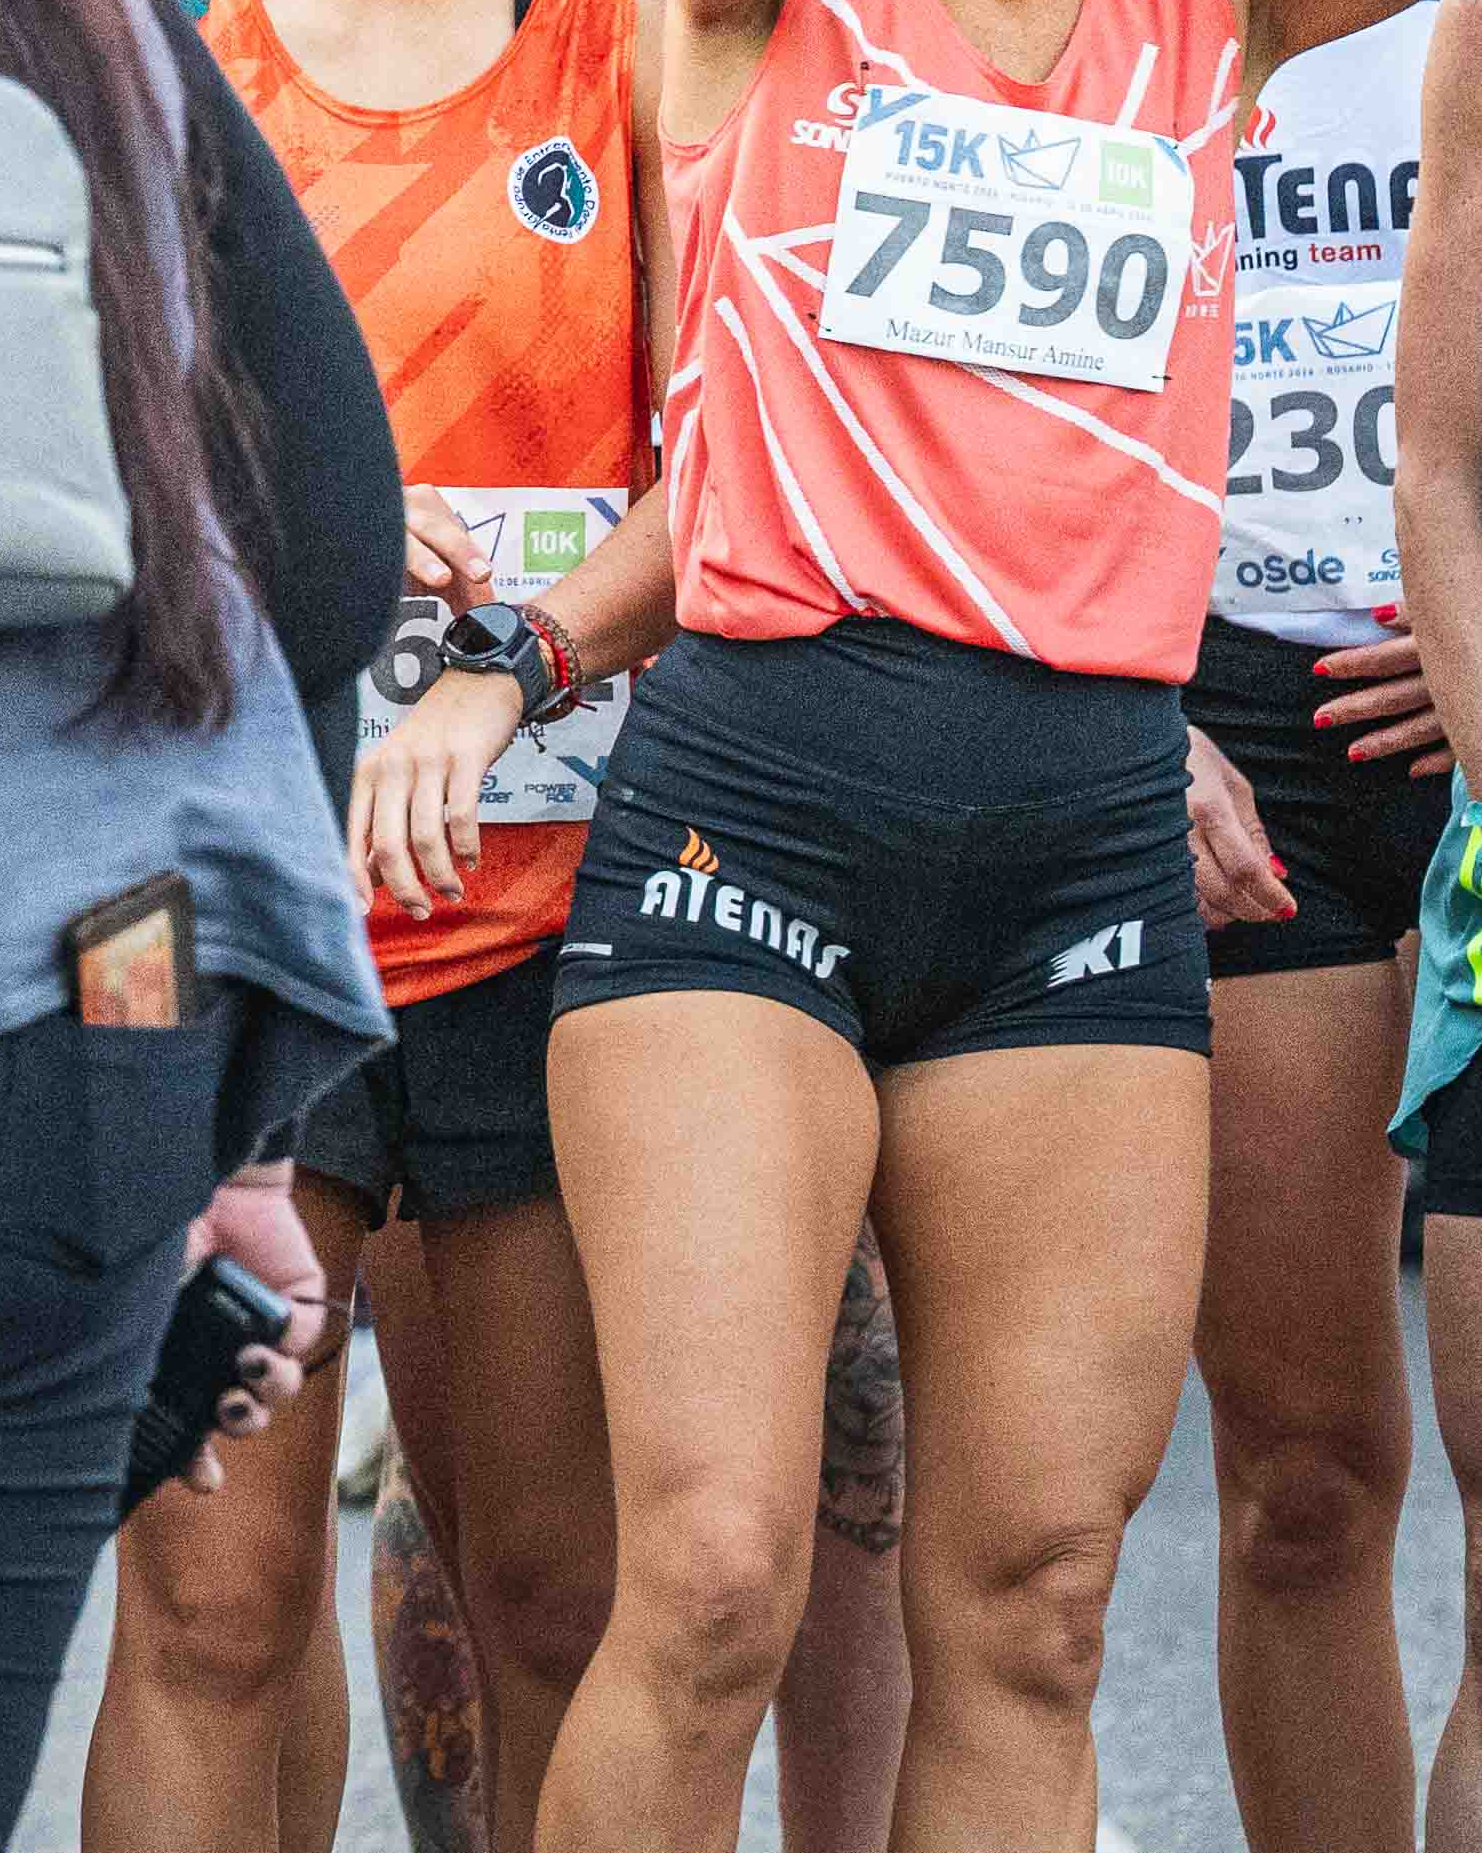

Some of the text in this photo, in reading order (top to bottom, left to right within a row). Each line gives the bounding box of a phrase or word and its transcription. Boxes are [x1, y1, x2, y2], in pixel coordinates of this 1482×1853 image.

[894, 119, 989, 179] 15K
[1234, 153, 1420, 241] TENA
[844, 190, 1169, 341] 7590
[1235, 243, 1382, 271] ning team
[885, 317, 1106, 372] Mazur Mansur Amine
[1234, 318, 1298, 366] 5K
[528, 527, 580, 556] 10K
[1235, 548, 1346, 593] osde
[357, 716, 391, 740] Ghi
[640, 866, 851, 980] ATENAS
